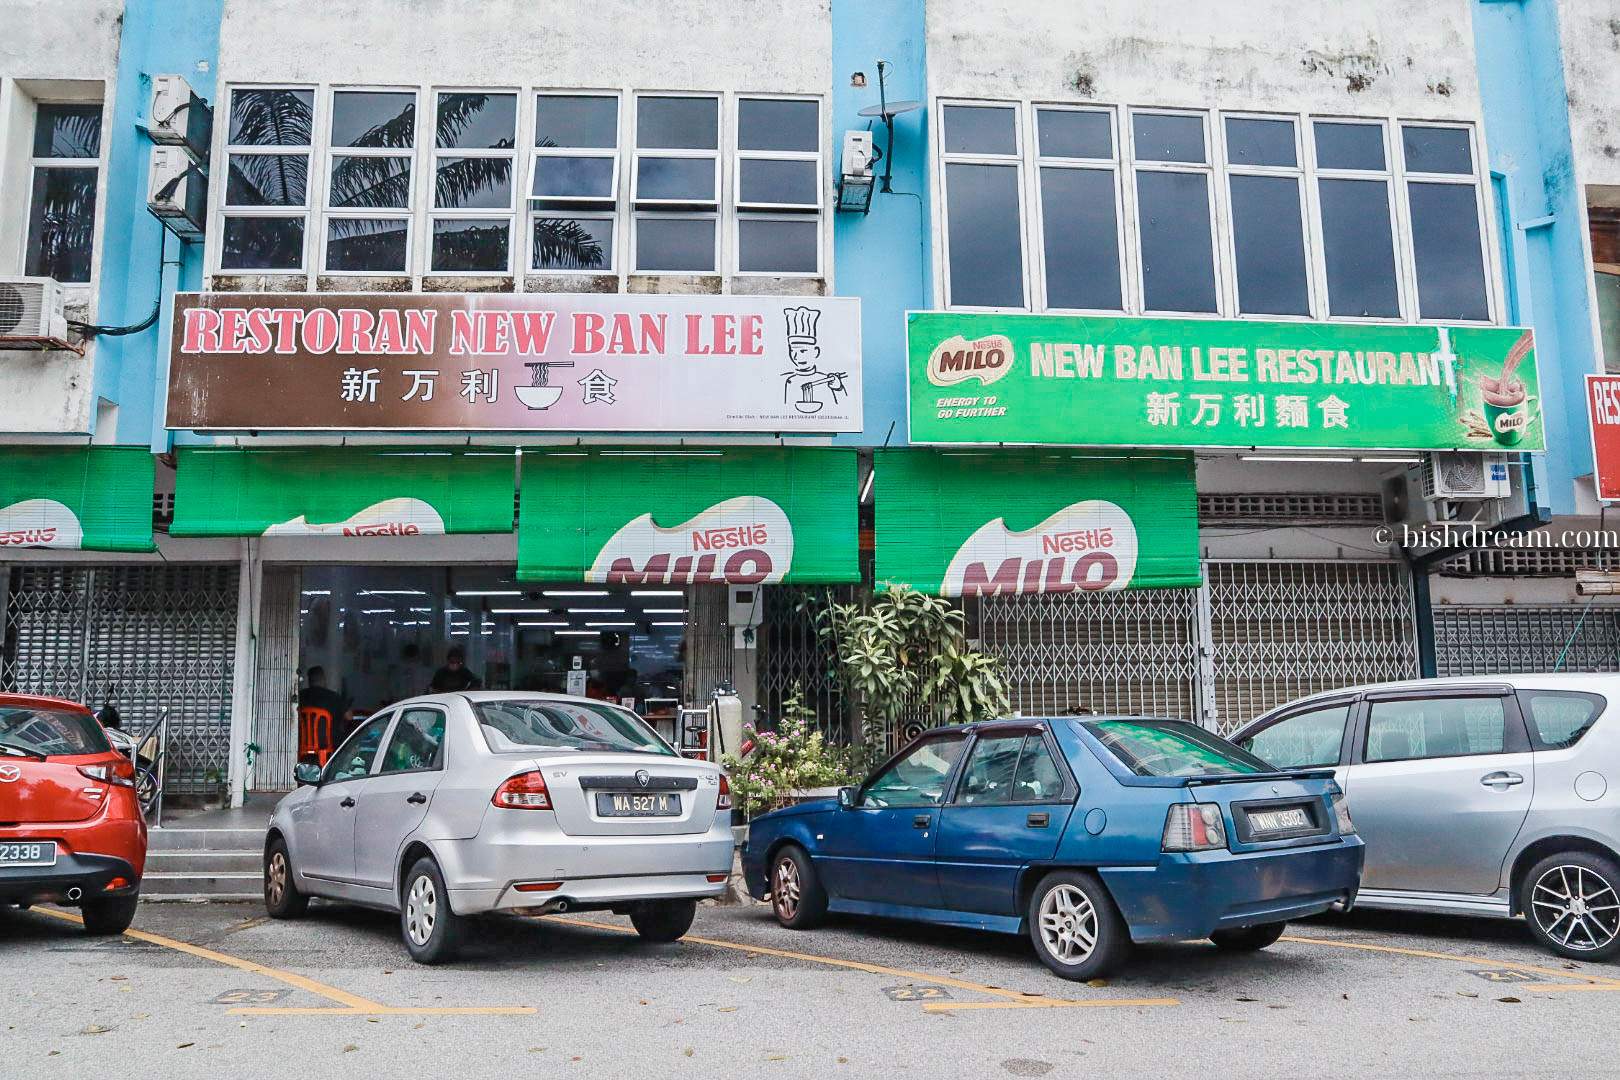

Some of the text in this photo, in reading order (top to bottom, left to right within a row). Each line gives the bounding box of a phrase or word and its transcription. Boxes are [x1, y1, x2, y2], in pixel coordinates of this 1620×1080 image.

[181, 308, 765, 357] RESTORAN NEW BAN LEE
[940, 349, 1005, 372] MILO
[1030, 342, 1458, 388] NEW BAN LEE RESTAURANT
[936, 396, 997, 407] ENERGY TO
[937, 406, 1007, 419] GO FURTHER
[1500, 417, 1523, 428] MILO
[692, 523, 768, 551] Nestlé
[1042, 527, 1114, 555] Nestlé
[606, 549, 773, 584] MILO
[960, 552, 1119, 597] MILO
[613, 796, 668, 811] WA 527 M
[0, 845, 41, 860] 2338
